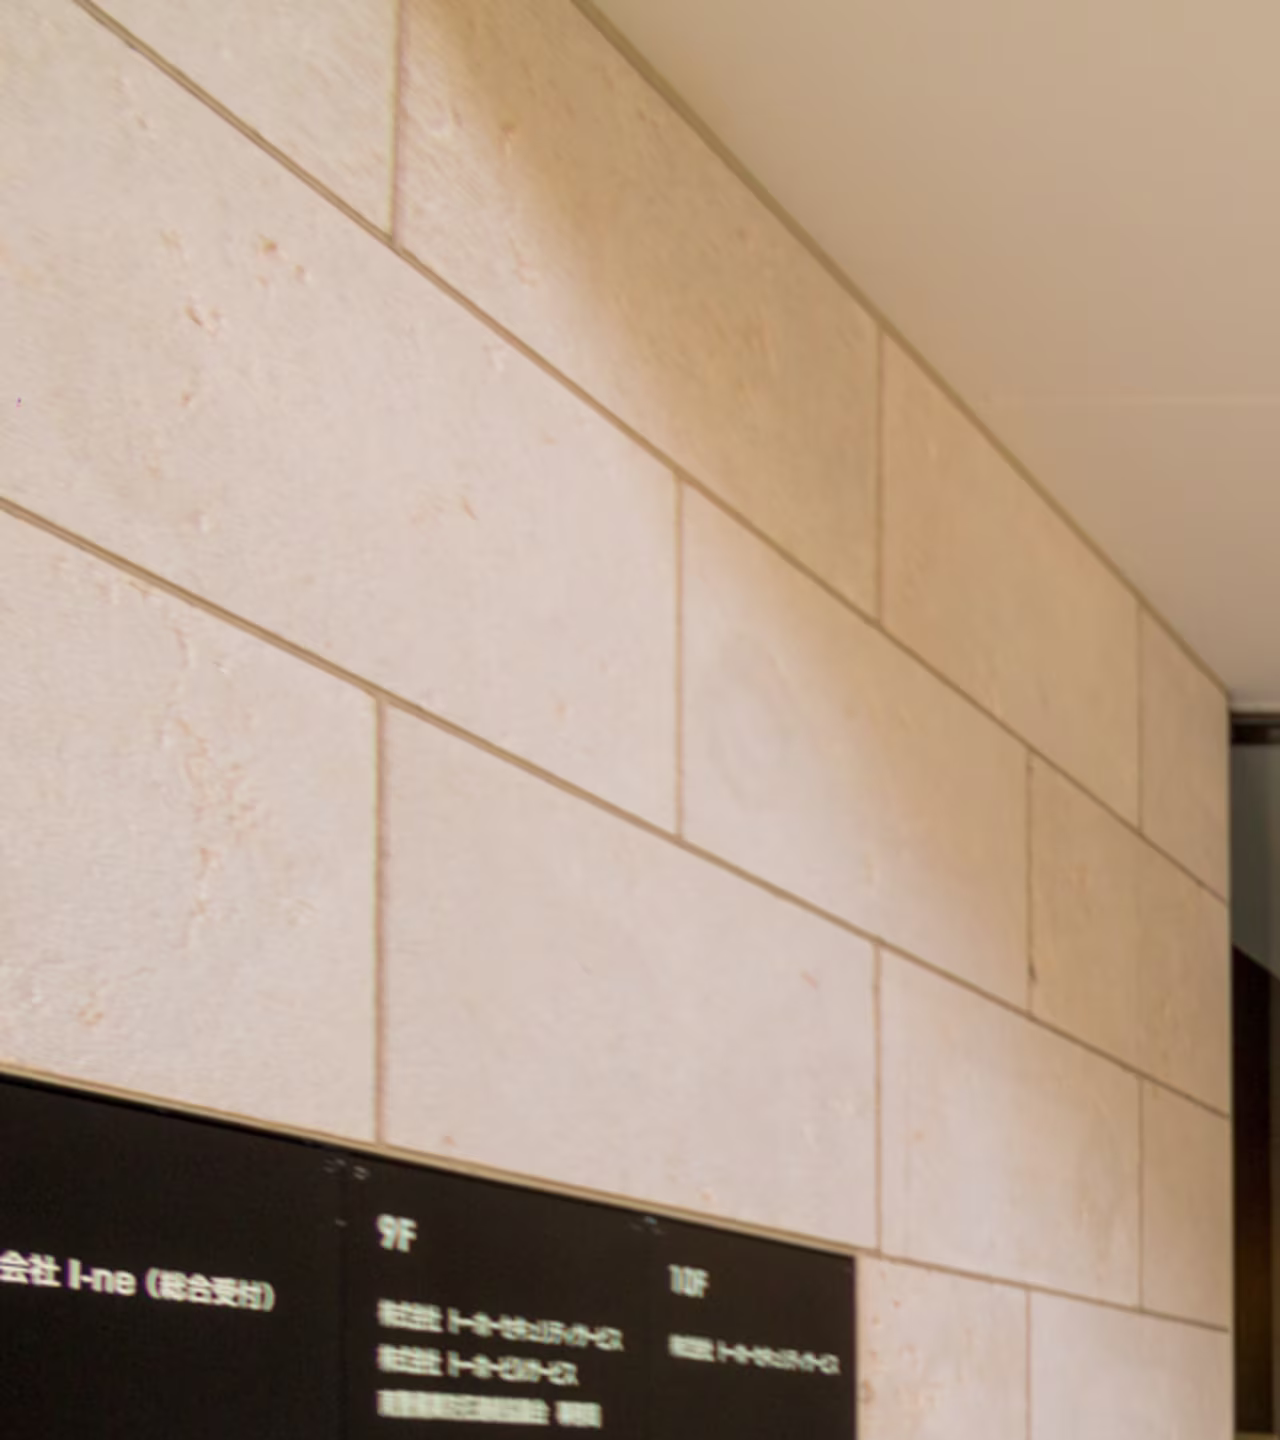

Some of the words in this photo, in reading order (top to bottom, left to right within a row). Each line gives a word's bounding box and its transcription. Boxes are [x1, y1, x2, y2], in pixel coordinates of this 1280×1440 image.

[377, 1214, 417, 1252] 9F
[68, 1258, 137, 1296] I-ne
[668, 1263, 710, 1298] 10F
